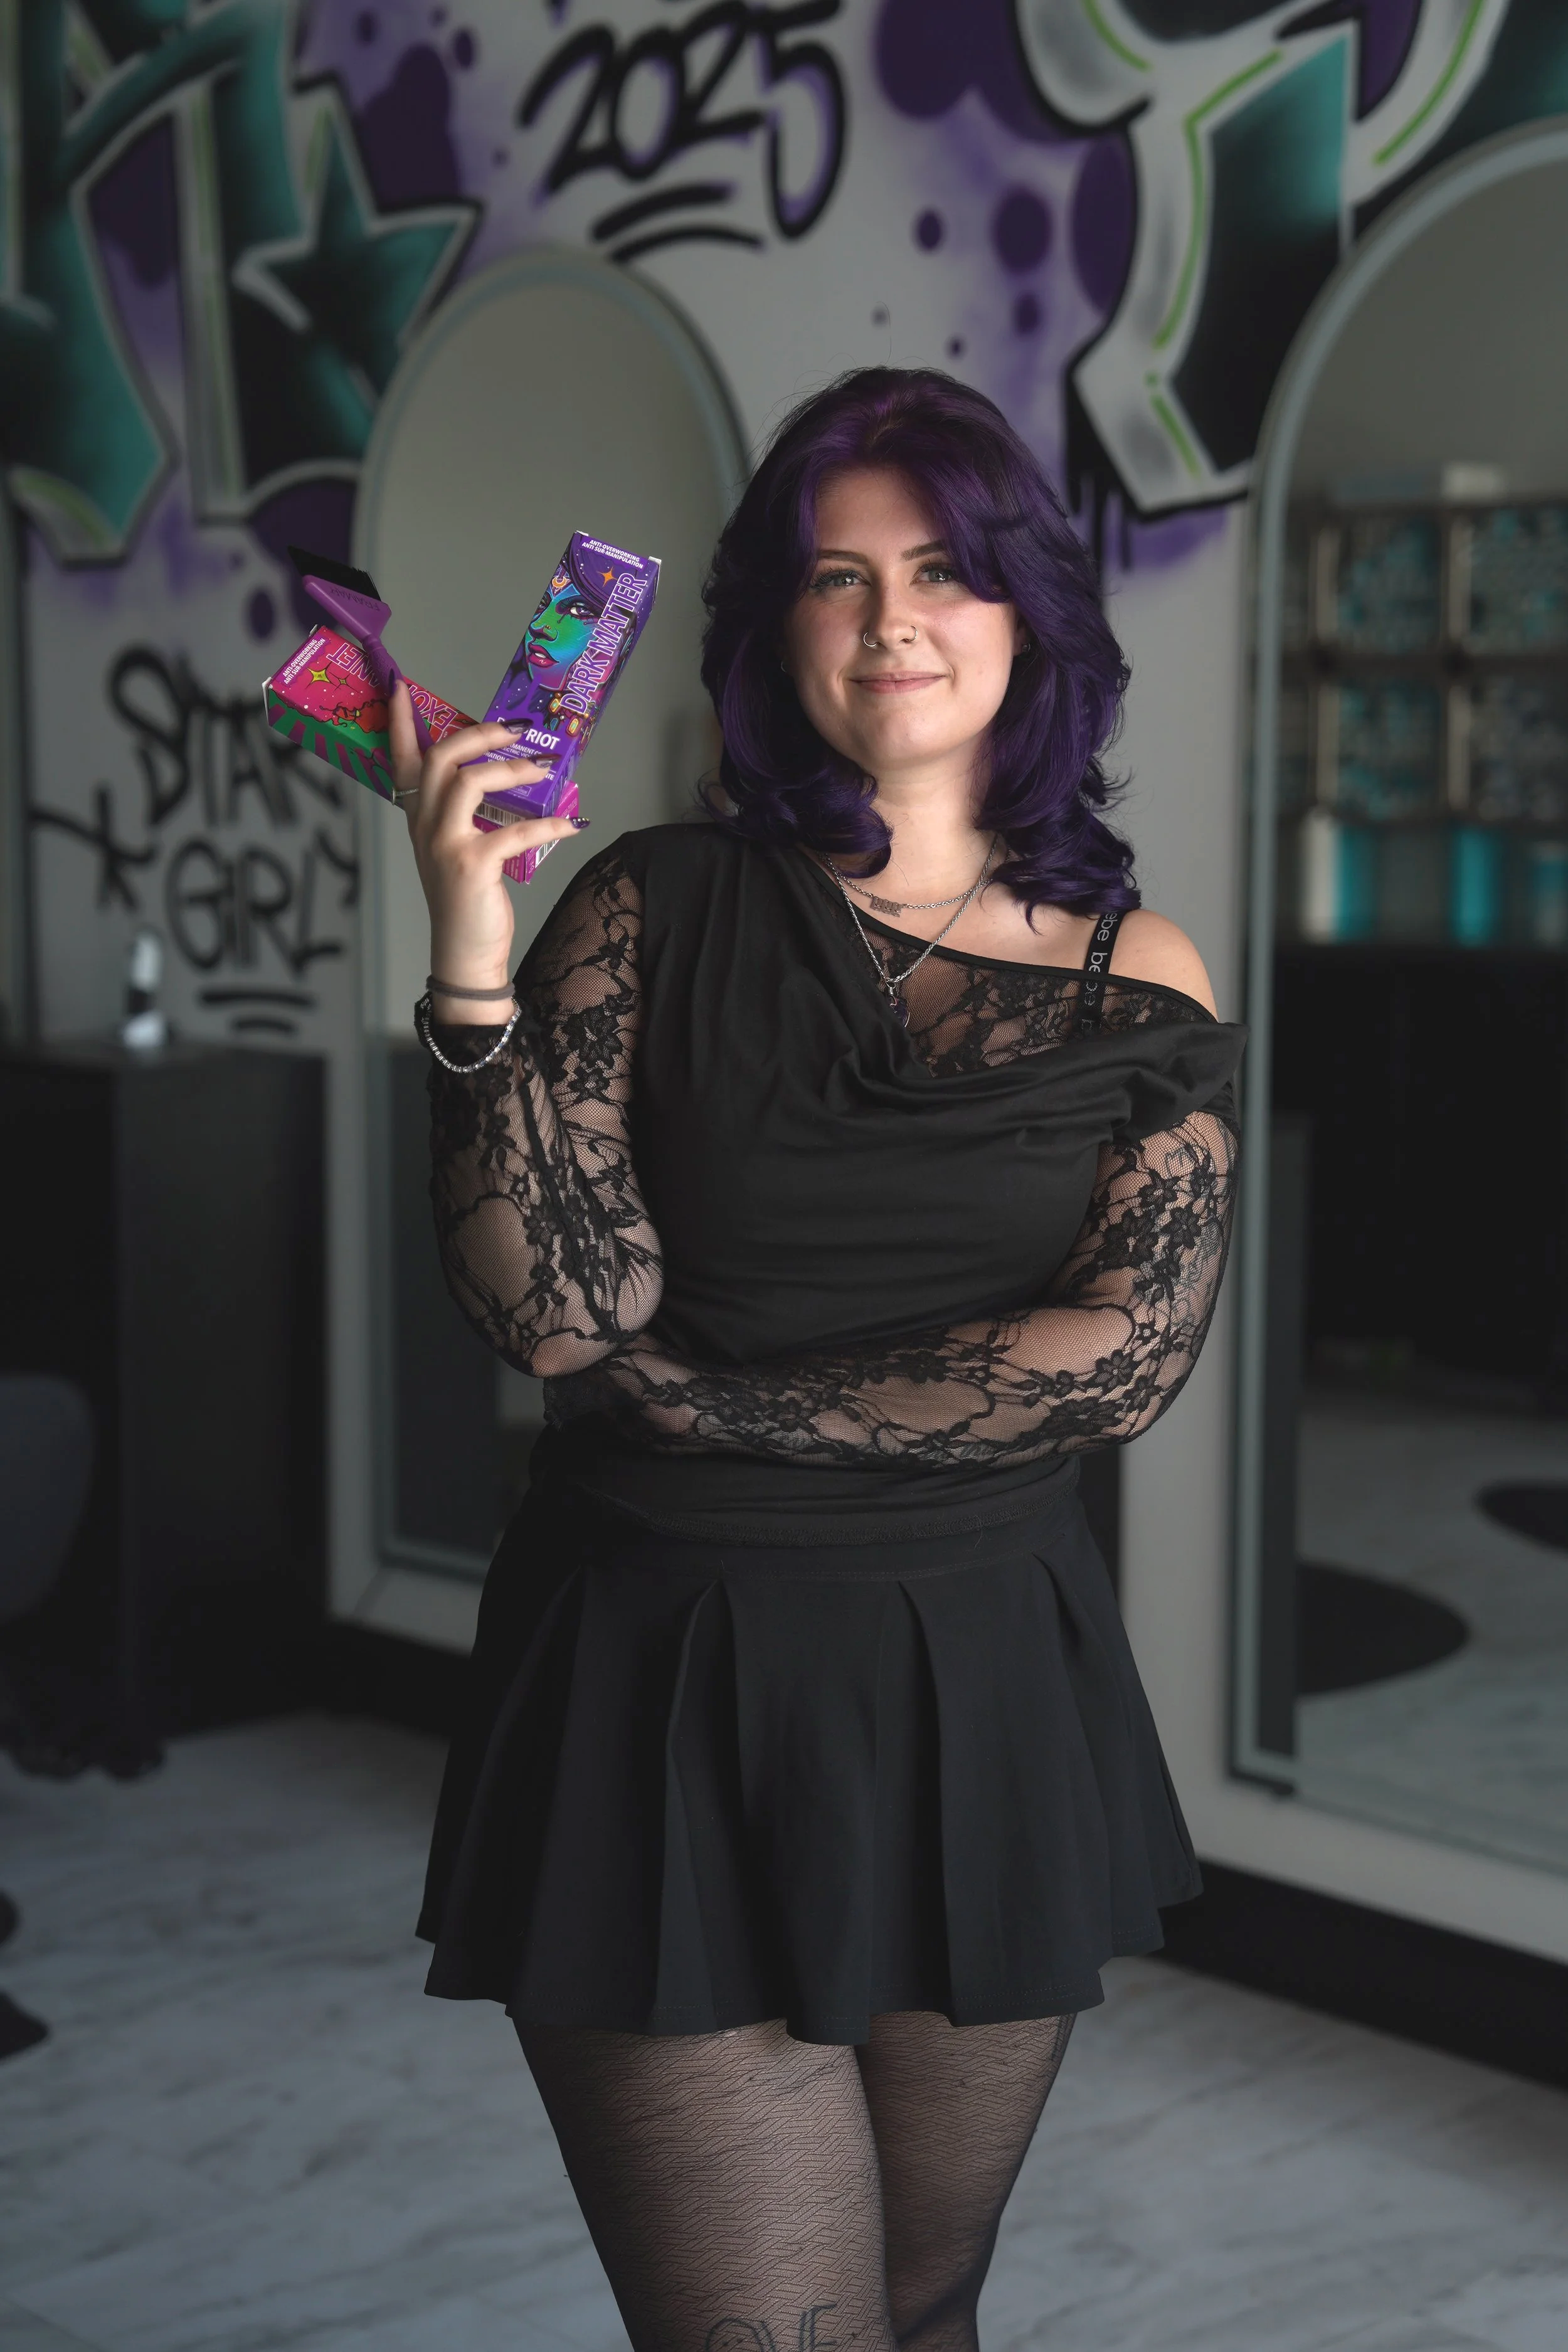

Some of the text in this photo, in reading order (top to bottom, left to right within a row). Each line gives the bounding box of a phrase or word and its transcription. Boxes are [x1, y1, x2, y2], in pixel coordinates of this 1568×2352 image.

[517, 0, 848, 241] 2025
[581, 542, 644, 569] ANTI SUR-MANIPULATION
[590, 539, 640, 562] ANTI-OVERWORKING
[282, 638, 318, 677] ANTI-OVERWORKING
[291, 638, 326, 675] SUR-MANIPULATION
[559, 573, 647, 714] DARK MATTER
